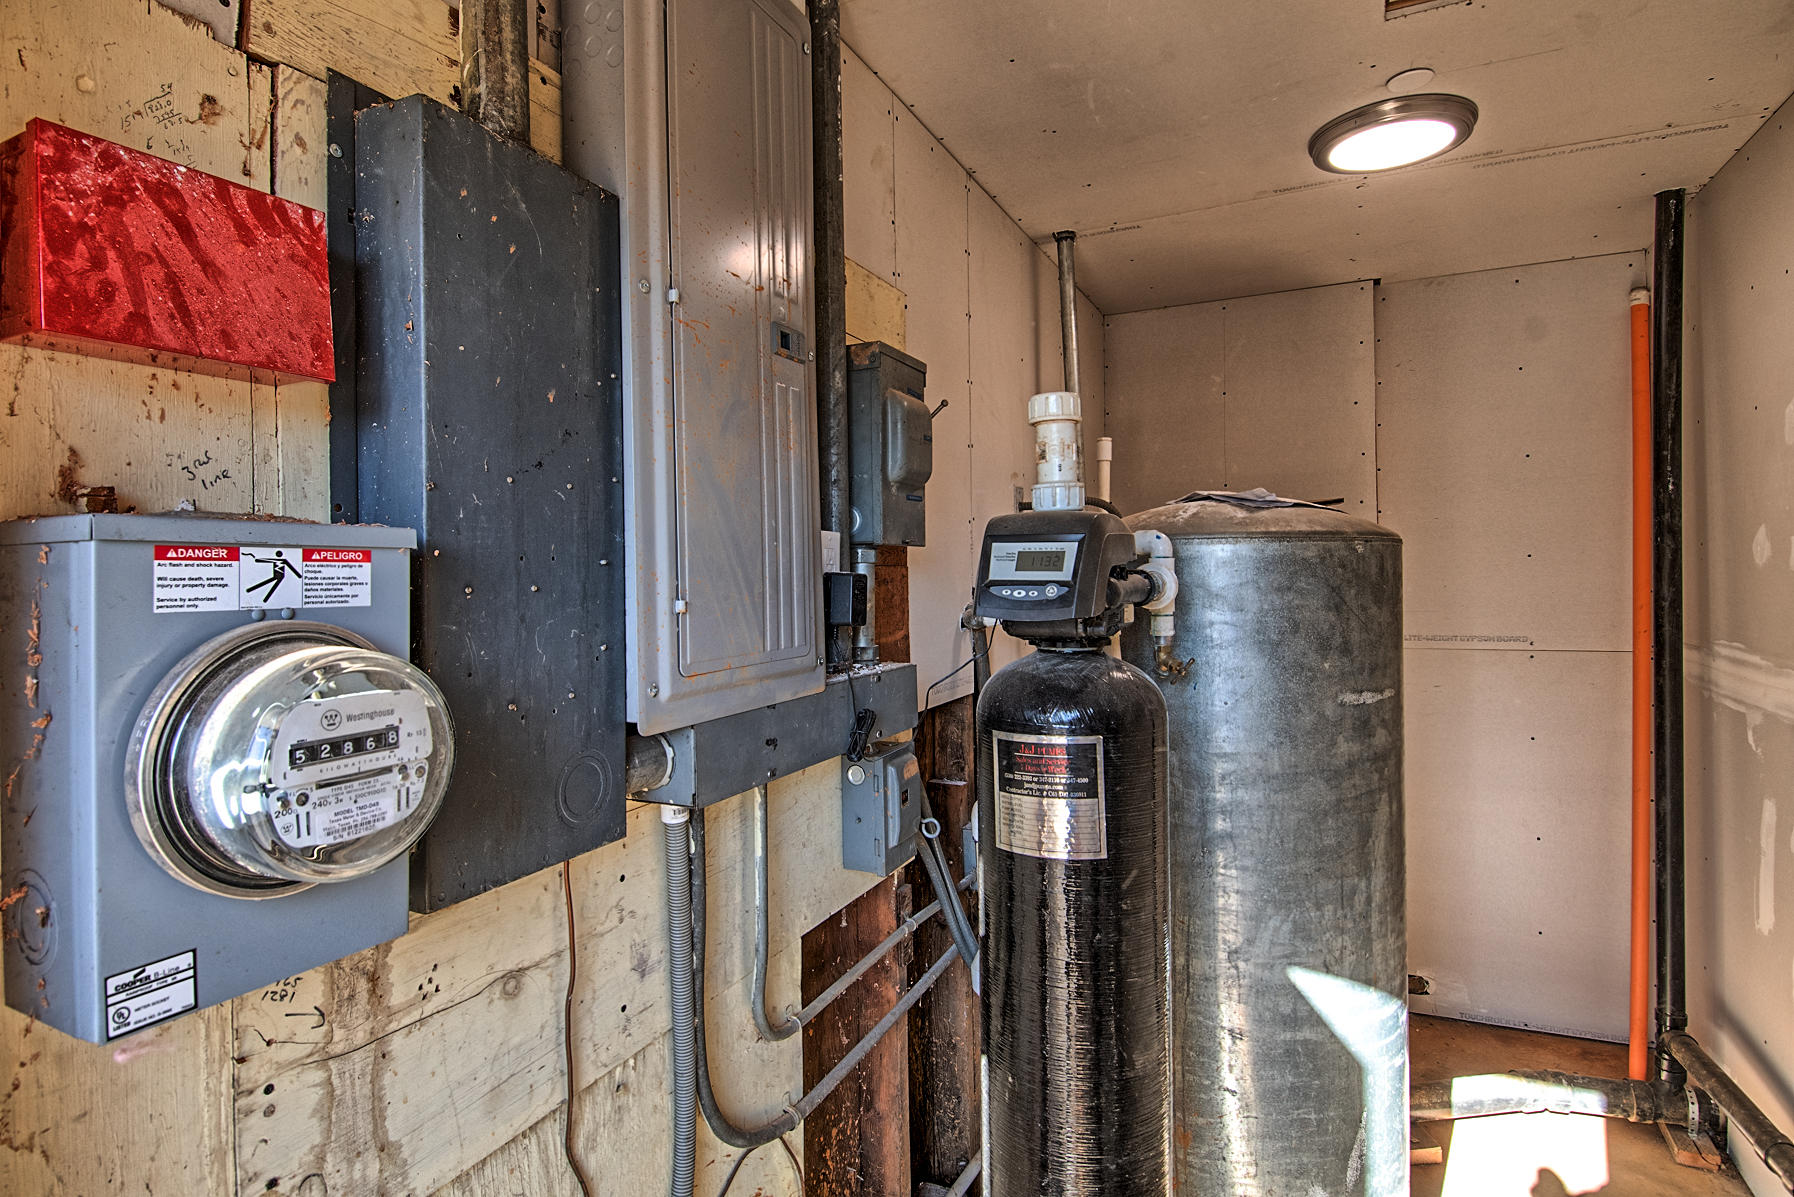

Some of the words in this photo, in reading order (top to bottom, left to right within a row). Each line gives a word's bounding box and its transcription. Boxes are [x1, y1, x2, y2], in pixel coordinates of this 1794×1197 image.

[178, 548, 229, 558] DANGER
[320, 551, 363, 560] PELIGRO
[346, 708, 395, 722] Westinghouse
[1037, 746, 1066, 755] PUMPS
[333, 808, 354, 817] MODEL
[114, 974, 152, 992] COOPER
[153, 965, 180, 979] B-Line
[261, 988, 296, 1003] 1281
